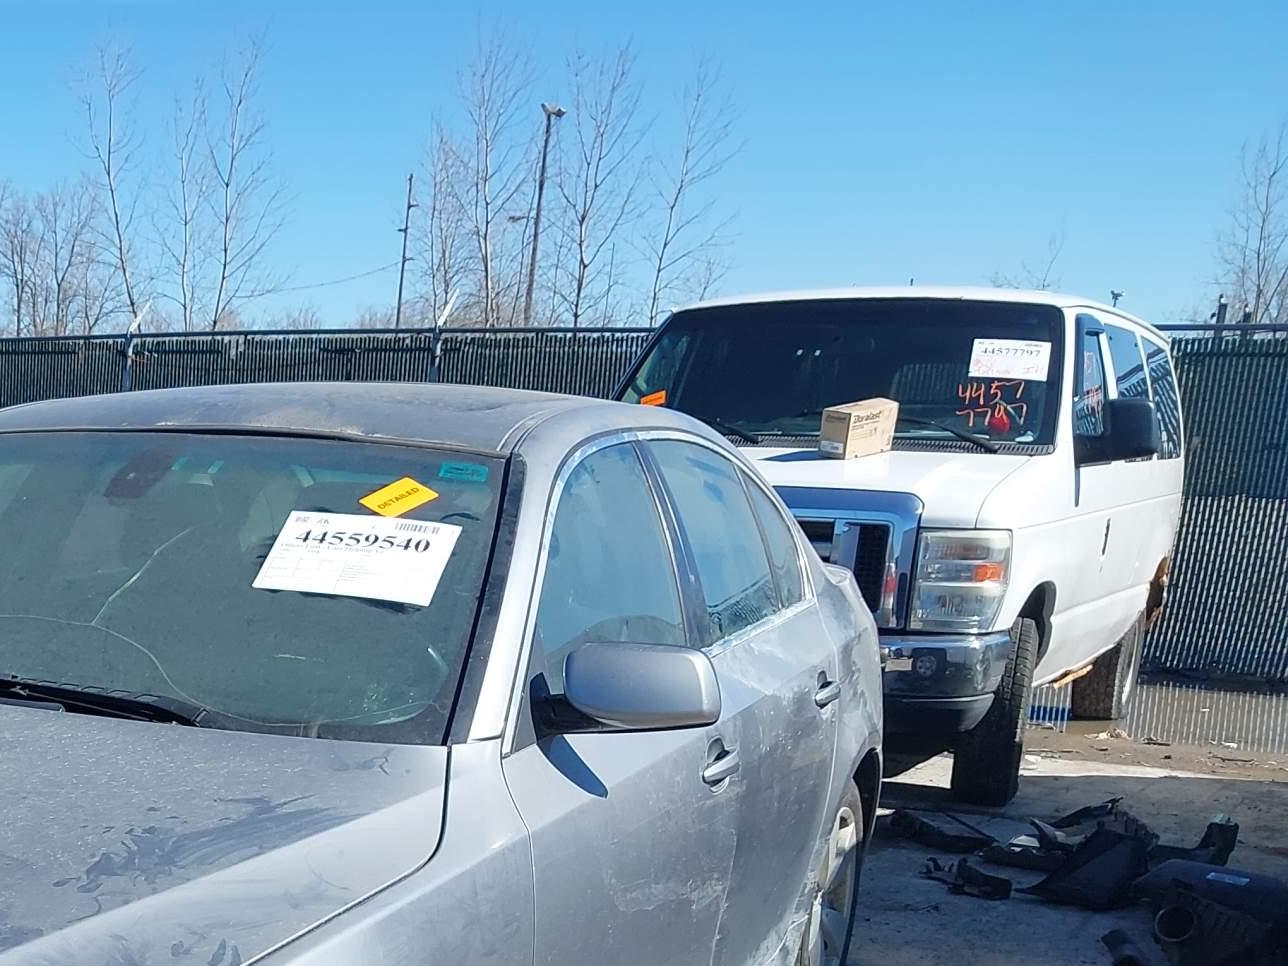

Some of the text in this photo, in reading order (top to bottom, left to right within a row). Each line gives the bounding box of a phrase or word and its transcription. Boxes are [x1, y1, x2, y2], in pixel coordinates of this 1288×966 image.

[958, 380, 1024, 405] 4457
[377, 487, 420, 510] DETAILED
[295, 529, 431, 553] 44559540
